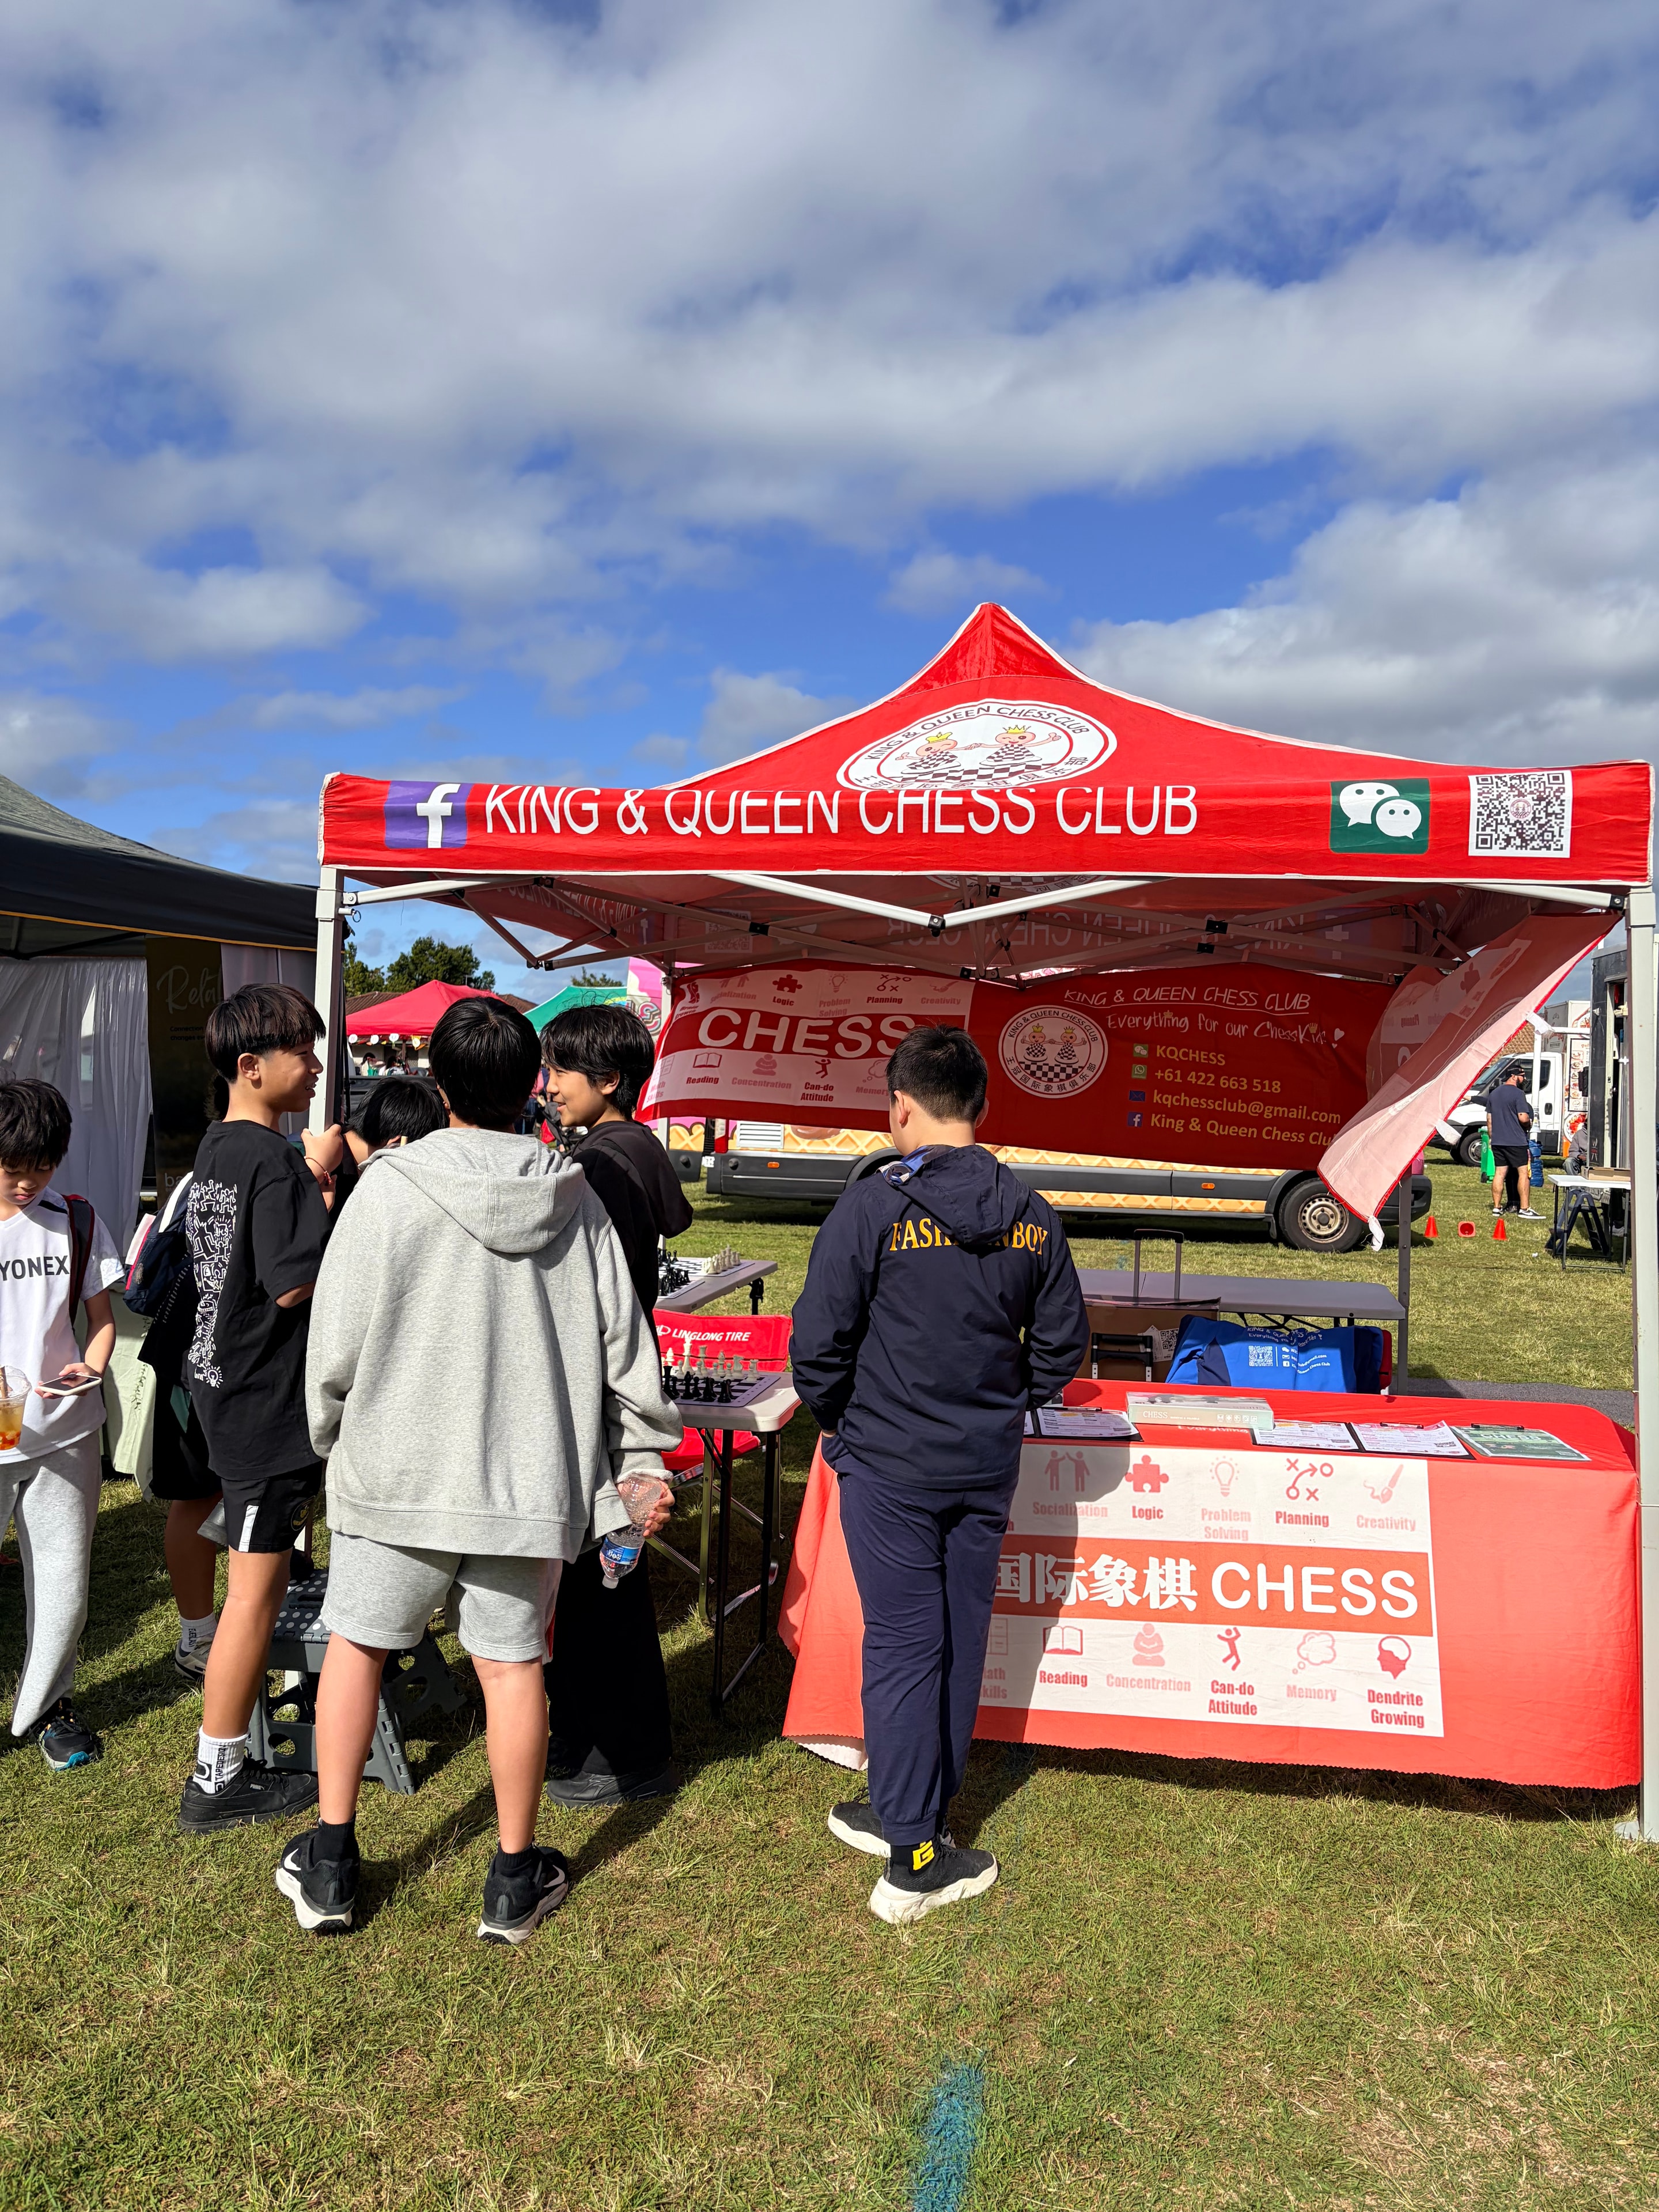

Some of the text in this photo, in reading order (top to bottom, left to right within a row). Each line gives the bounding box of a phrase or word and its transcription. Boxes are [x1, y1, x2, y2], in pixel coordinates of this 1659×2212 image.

[865, 706, 1089, 760] KING & QUEEN CHESS CLUB
[486, 784, 1198, 838] KING & QUEEN CHESS CLUB
[772, 996, 794, 1006] Logic
[819, 998, 850, 1007] Problem
[921, 997, 961, 1005] Creativity
[1065, 987, 1310, 1010] KING & QUEEN CHESS CLUB
[819, 1009, 847, 1018] Solving
[1008, 1021, 1024, 1038] KING
[1030, 1010, 1059, 1018] QUEEN
[1061, 1012, 1086, 1026] CHESS
[1084, 1025, 1098, 1042] CLUB
[1106, 1011, 1189, 1032] Everything
[1198, 1013, 1218, 1032] for
[1226, 1022, 1248, 1037] our
[698, 1009, 915, 1058] CHESS
[1157, 1045, 1226, 1066] KQCHESS
[686, 1076, 719, 1085] Reading
[1006, 1056, 1096, 1092] 王冠国际象棋俱乐部
[1155, 1069, 1281, 1093] +61 422 663 518
[732, 1077, 792, 1089] Concentration
[804, 1082, 834, 1091] Can-do
[801, 1093, 834, 1102] Attitude
[1153, 1089, 1342, 1124] kqchessclub@gmail.com
[1151, 1113, 1184, 1132] King
[1188, 1117, 1201, 1131] &
[1207, 1120, 1257, 1138] Queen
[1262, 1126, 1305, 1143] Chess
[0, 1255, 70, 1281] YONEX
[672, 1328, 725, 1342] LINGLONG
[725, 1332, 751, 1342] TIRE
[1143, 1410, 1168, 1419] CHESS
[1033, 1502, 1108, 1517] Socialization
[1132, 1506, 1164, 1520] Logic
[1201, 1508, 1251, 1522] Problem
[1275, 1511, 1330, 1528] Planning
[1356, 1514, 1416, 1532] Creativity
[1204, 1526, 1249, 1541] Solving
[995, 1552, 1418, 1619] 国际象棋 CHESS
[1039, 1671, 1088, 1687] Reading
[1106, 1673, 1192, 1692] Concentration
[1211, 1680, 1255, 1695] Can-do
[1286, 1684, 1337, 1702] Memory
[1367, 1689, 1423, 1707] Dendrite
[1208, 1699, 1257, 1716] Attitude
[1371, 1709, 1425, 1729] Growing
